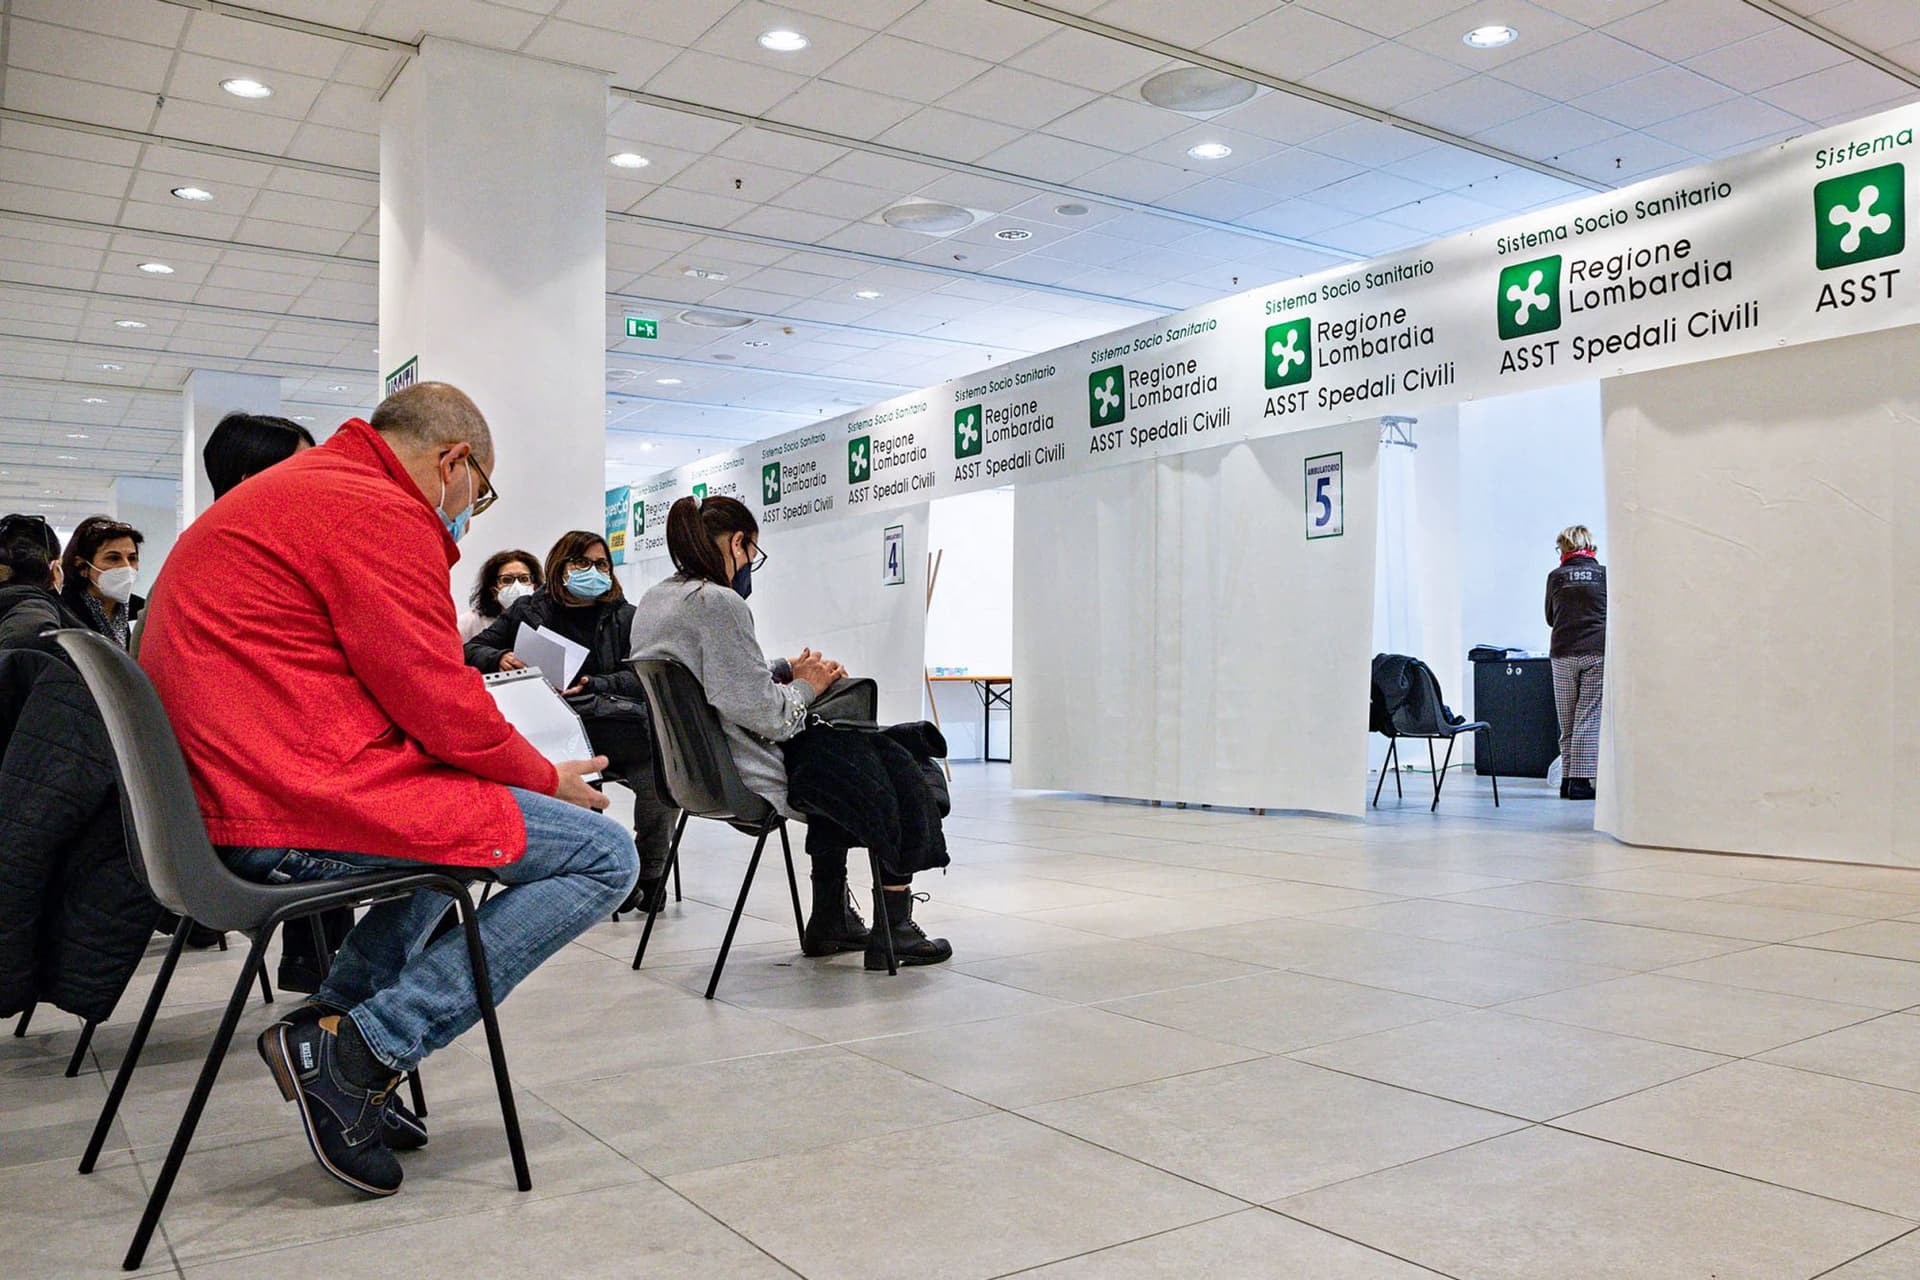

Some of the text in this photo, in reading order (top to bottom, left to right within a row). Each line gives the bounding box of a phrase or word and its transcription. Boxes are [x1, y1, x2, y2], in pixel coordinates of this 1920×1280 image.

[1815, 128, 1913, 170] Sistema
[1497, 181, 1732, 256] Sistema Socio Sanitario
[1569, 238, 1691, 283] Regione
[1265, 259, 1434, 315] Sistema Socio Sanitario
[1569, 258, 1733, 314] Lombardia
[1815, 269, 1900, 312] ASST
[1091, 318, 1217, 364] Sistema Socio Sanitario
[1317, 306, 1407, 342] Regione
[1499, 301, 1759, 375] ASST Spedali Civili
[1318, 324, 1435, 368] Lombardia
[954, 366, 1055, 402] Sistema Socio Sanitario
[1129, 359, 1197, 387] Regione
[1263, 362, 1455, 418] ASST Spedali Civili
[1129, 375, 1217, 410] Lombardia
[847, 401, 928, 433] Sistema Socio Sanitario
[985, 400, 1038, 424] Regione
[985, 414, 1054, 444] Lombardia
[1089, 406, 1231, 454] ASST Spedali Civili
[872, 432, 915, 455] Regione
[872, 446, 927, 472] Lombardia
[782, 461, 816, 478] Regione
[954, 443, 1065, 482] ASST Spedali Civili
[782, 473, 827, 495] Lombardia
[848, 472, 936, 504] ASST Spedali Civili
[1315, 477, 1332, 527] 5
[762, 496, 834, 523] ASST Spedali Civili
[888, 542, 898, 576] 4
[1569, 571, 1593, 581] 1952
